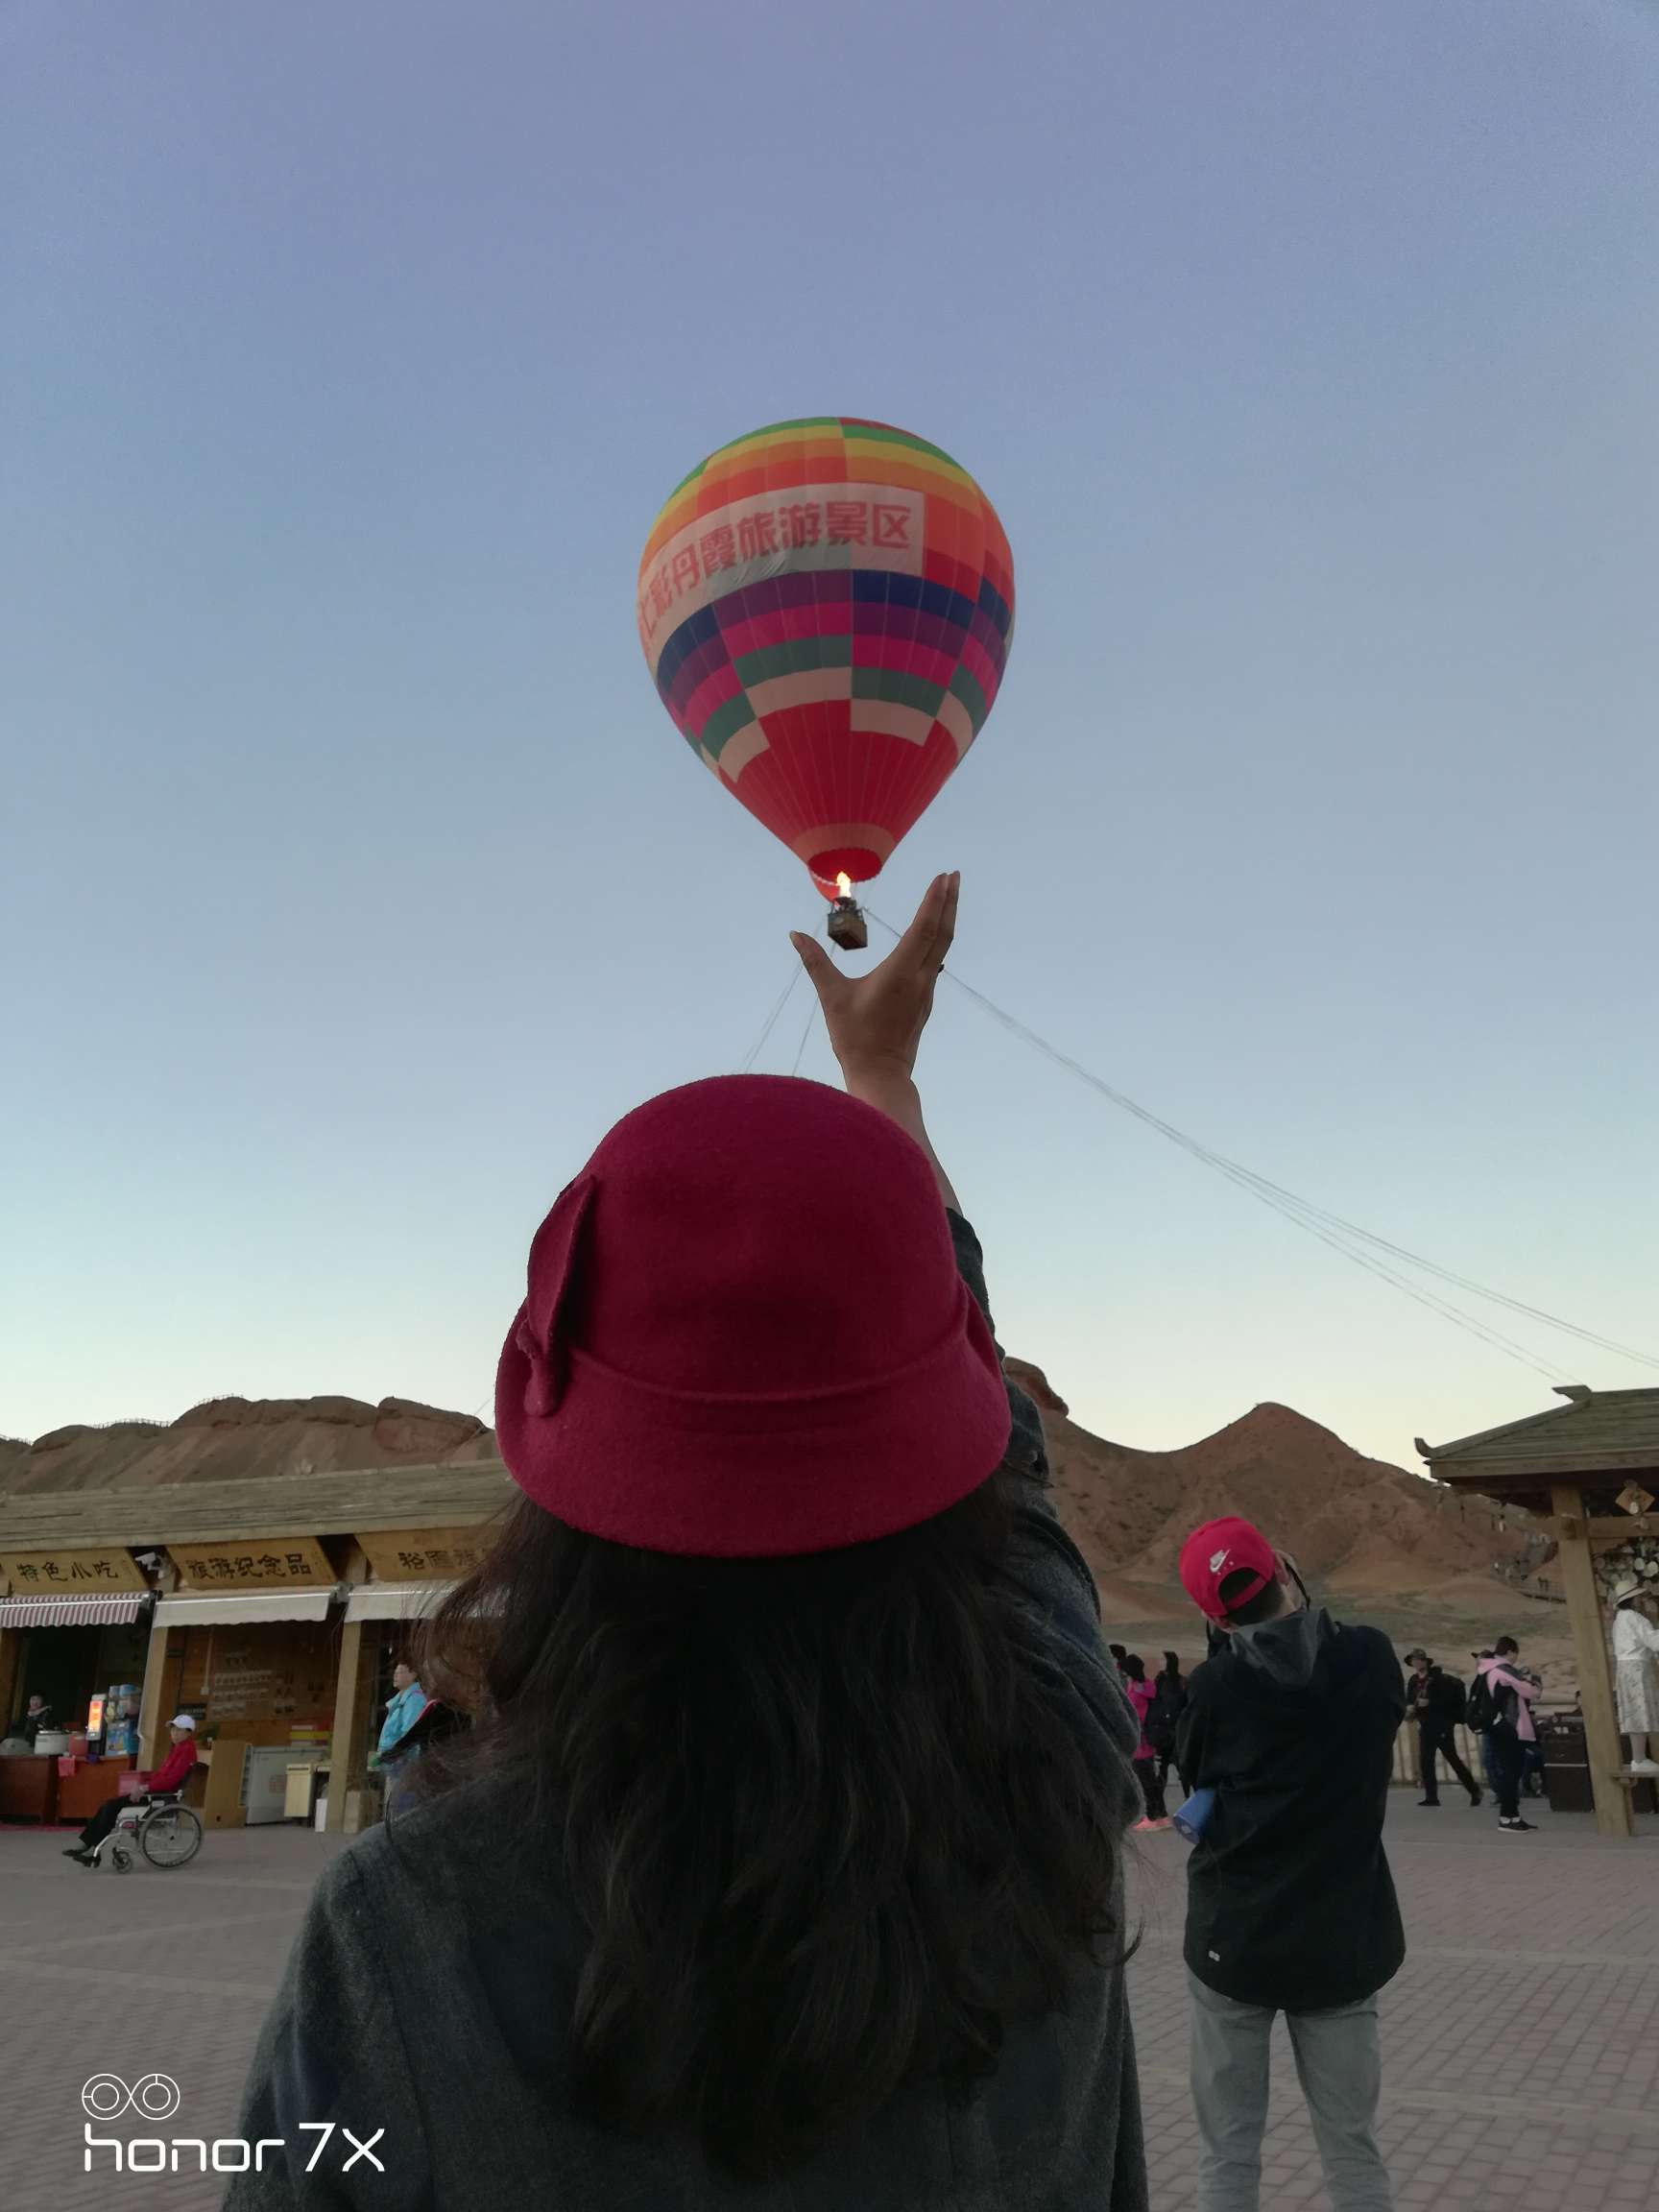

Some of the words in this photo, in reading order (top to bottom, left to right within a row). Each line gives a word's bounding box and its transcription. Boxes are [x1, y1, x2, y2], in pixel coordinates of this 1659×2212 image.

[638, 501, 911, 647] 七彩丹霞旅游景区
[16, 1561, 119, 1582] 特色小吃
[186, 1552, 312, 1579] 旅游纪念品
